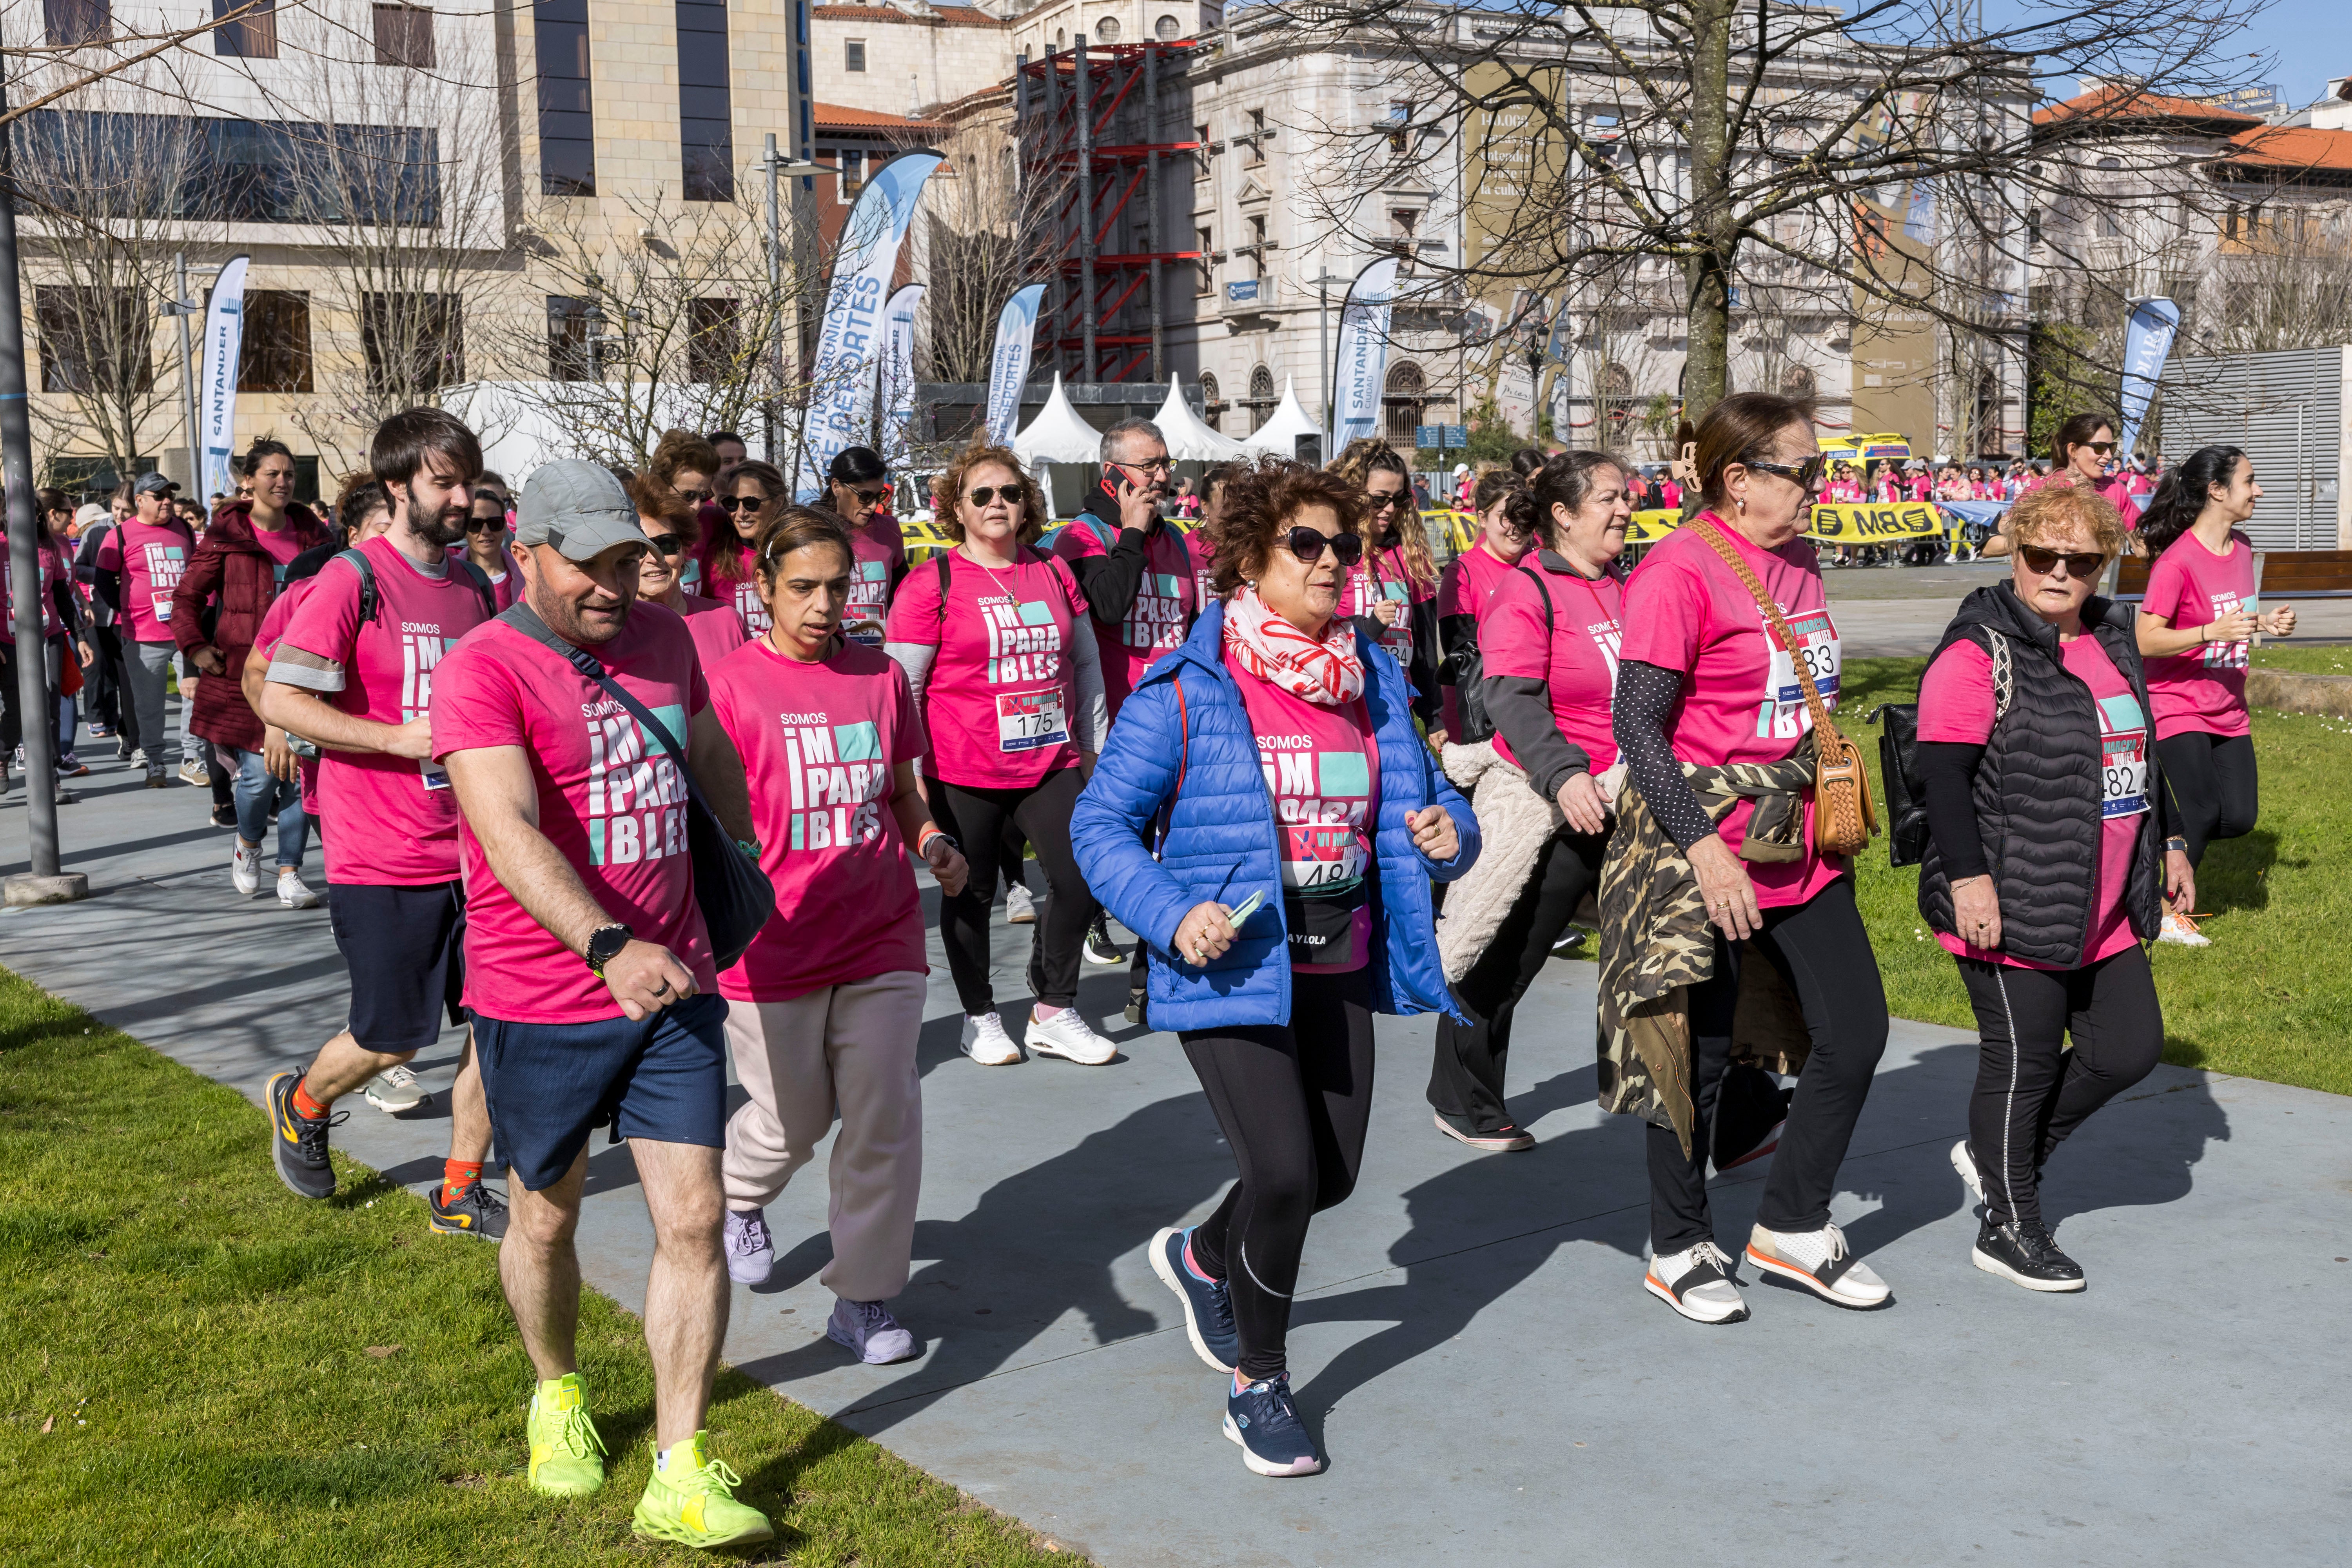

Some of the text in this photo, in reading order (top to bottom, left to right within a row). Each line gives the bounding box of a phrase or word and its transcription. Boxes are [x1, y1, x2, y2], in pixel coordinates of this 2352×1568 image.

[2237, 88, 2258, 102] 2000
[1481, 182, 1491, 195] la
[993, 343, 1005, 391] MUNICIPAL
[1352, 315, 1368, 409] SANTANDER
[214, 326, 227, 436] SANTANDER
[1001, 344, 1022, 417] DEPORTES
[1365, 375, 1374, 409] CIUDAD
[977, 596, 1009, 606] SOMOS
[2211, 591, 2236, 603] SOMOS
[401, 622, 440, 634] SOMOS
[1587, 619, 1620, 634] SOMOS
[1795, 617, 1829, 636] MARCHA
[1001, 625, 1061, 656] PARA
[1807, 629, 1833, 646] MUJER
[1022, 693, 1057, 706] VI MARCHA
[1039, 701, 1058, 712] MUJER
[581, 700, 626, 718] SOMOS
[780, 712, 828, 724] SOMOS
[1018, 712, 1053, 736] 175
[1257, 735, 1312, 749] SOMOS
[2103, 739, 2136, 755] MARCHA
[2112, 751, 2136, 766] MUJER
[608, 758, 689, 813] PARA
[807, 763, 885, 808] PARA
[1316, 832, 1329, 847] VI
[1296, 934, 1303, 943] Y
[1303, 935, 1326, 945] LOLA
